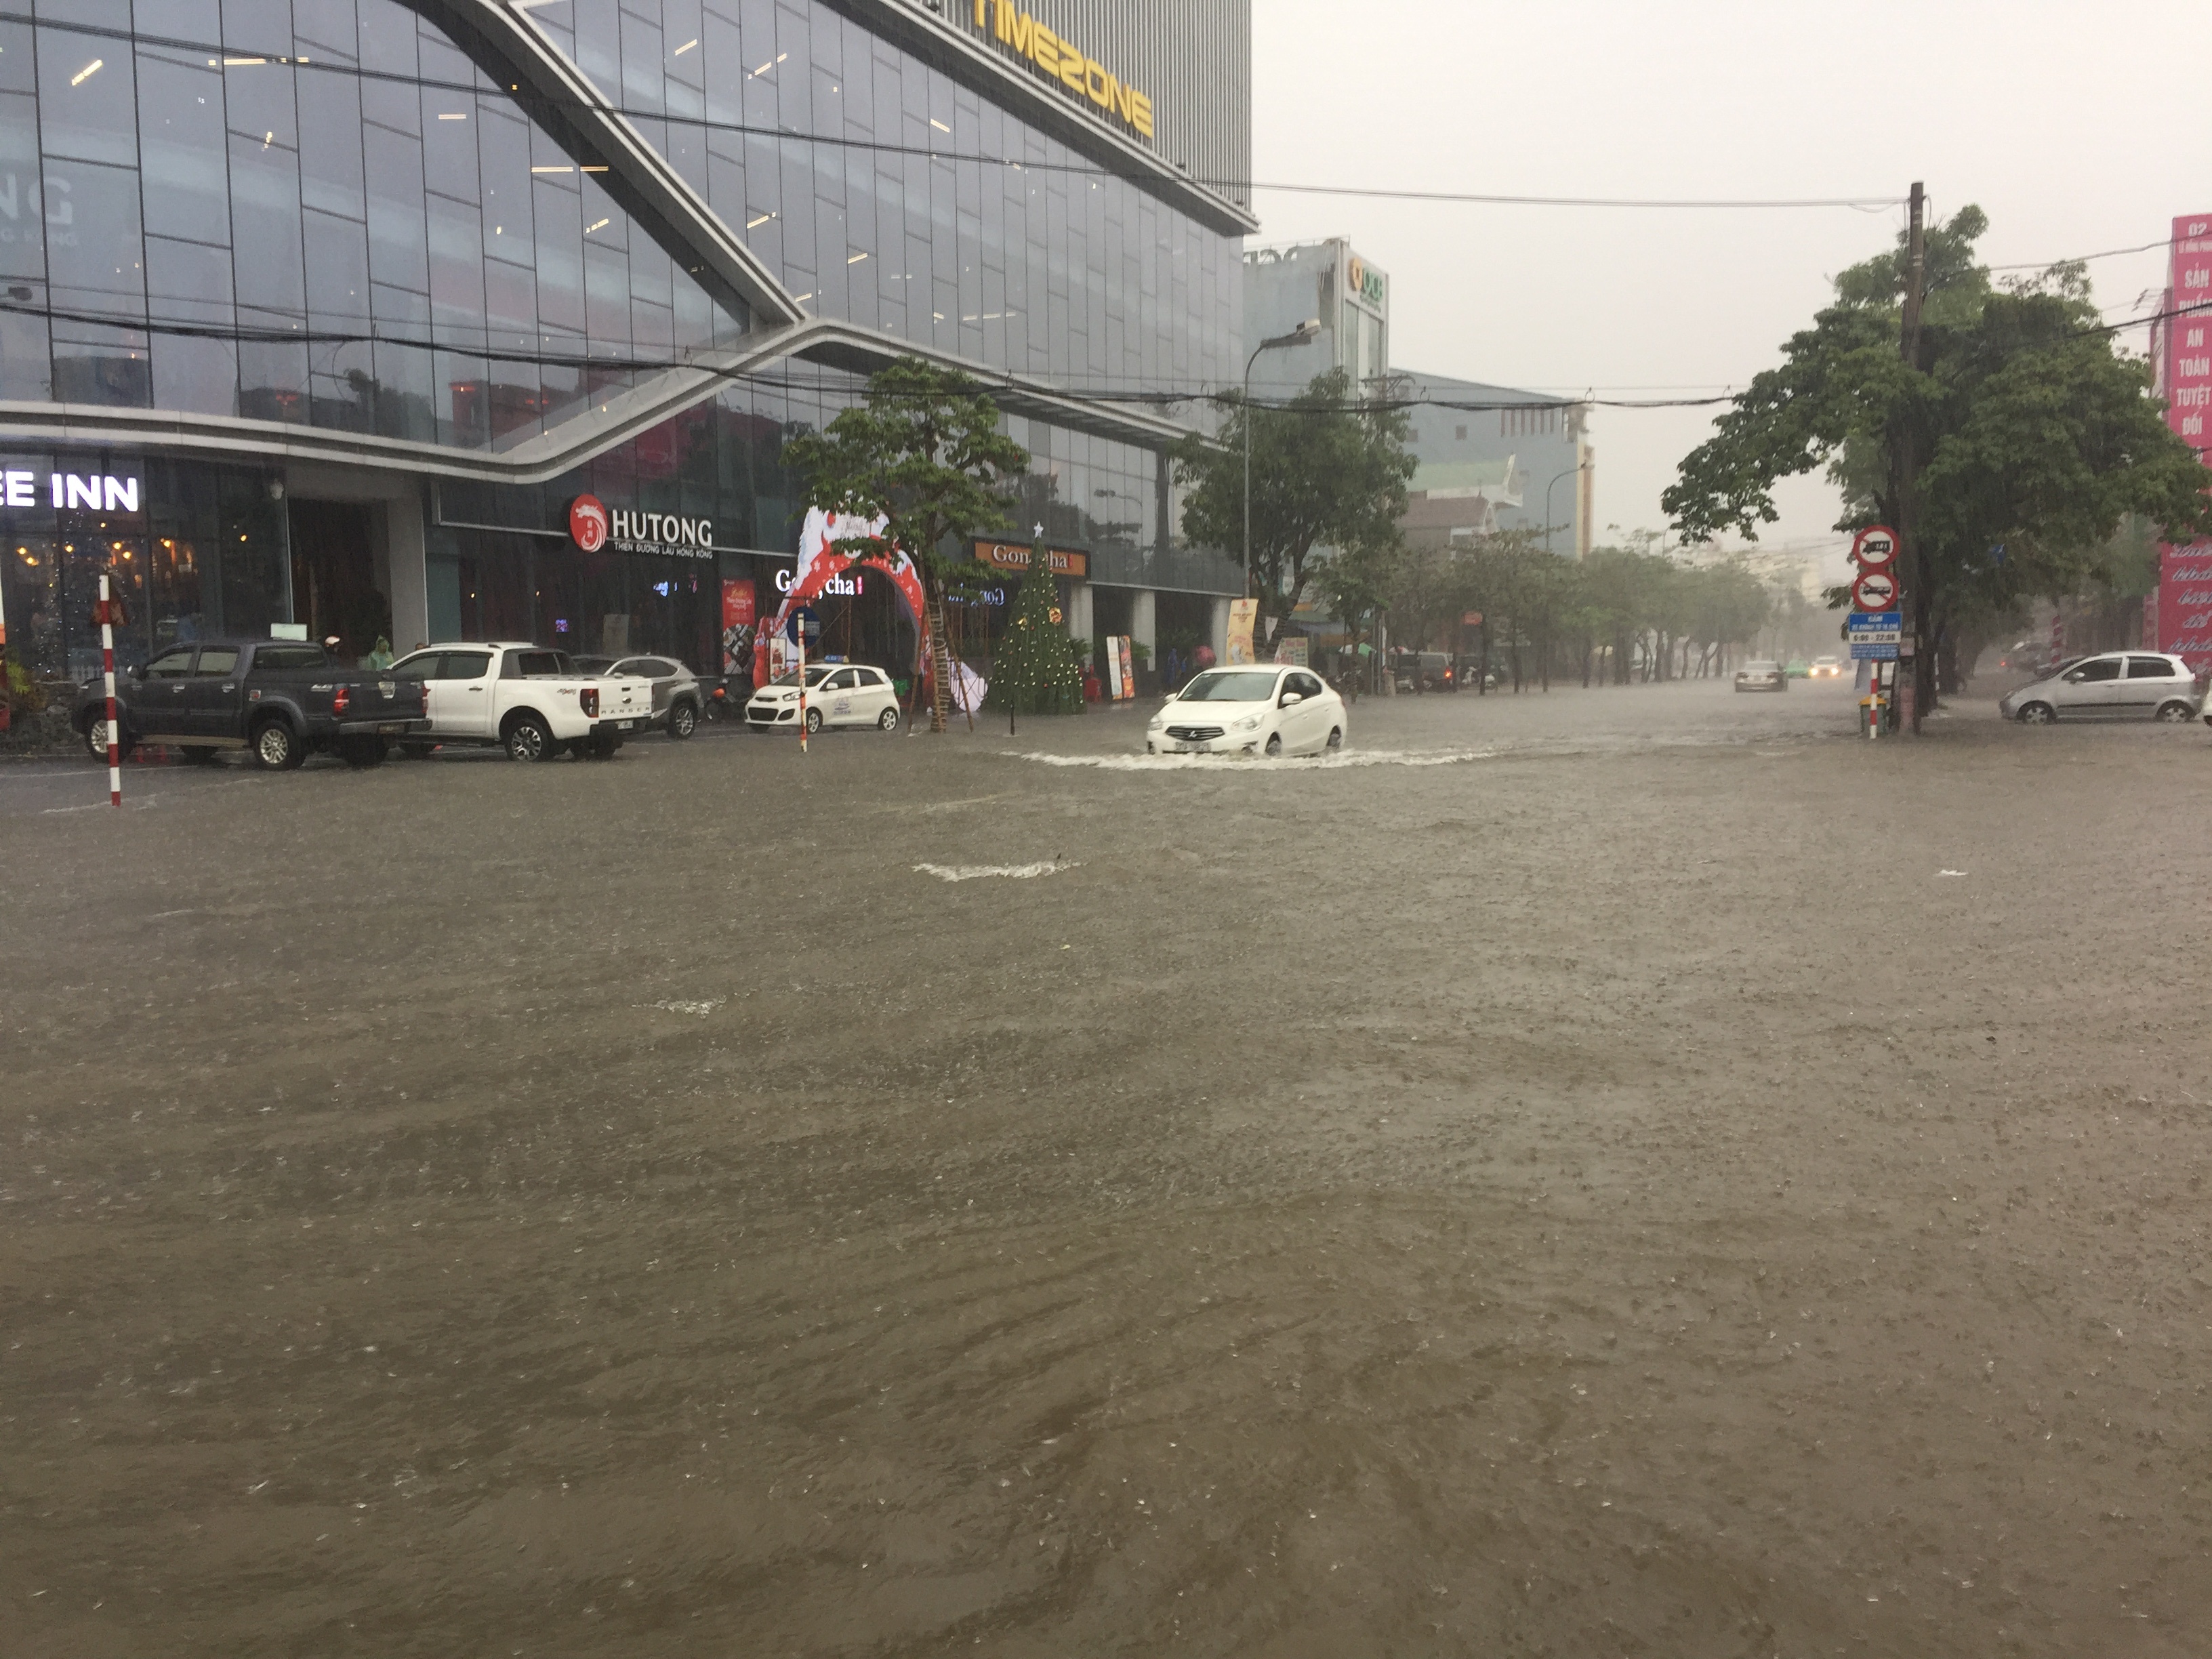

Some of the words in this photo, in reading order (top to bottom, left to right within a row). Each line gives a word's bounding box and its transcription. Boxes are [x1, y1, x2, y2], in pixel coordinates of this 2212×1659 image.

[975, 0, 1152, 138] TIMEZONE
[2189, 222, 2207, 237] 02
[2187, 328, 2204, 348] AN
[2179, 354, 2210, 377] TOÀN
[0, 471, 35, 507] E
[52, 473, 138, 512] INN
[613, 509, 712, 548] HUTONG
[600, 707, 650, 715] RANGER
